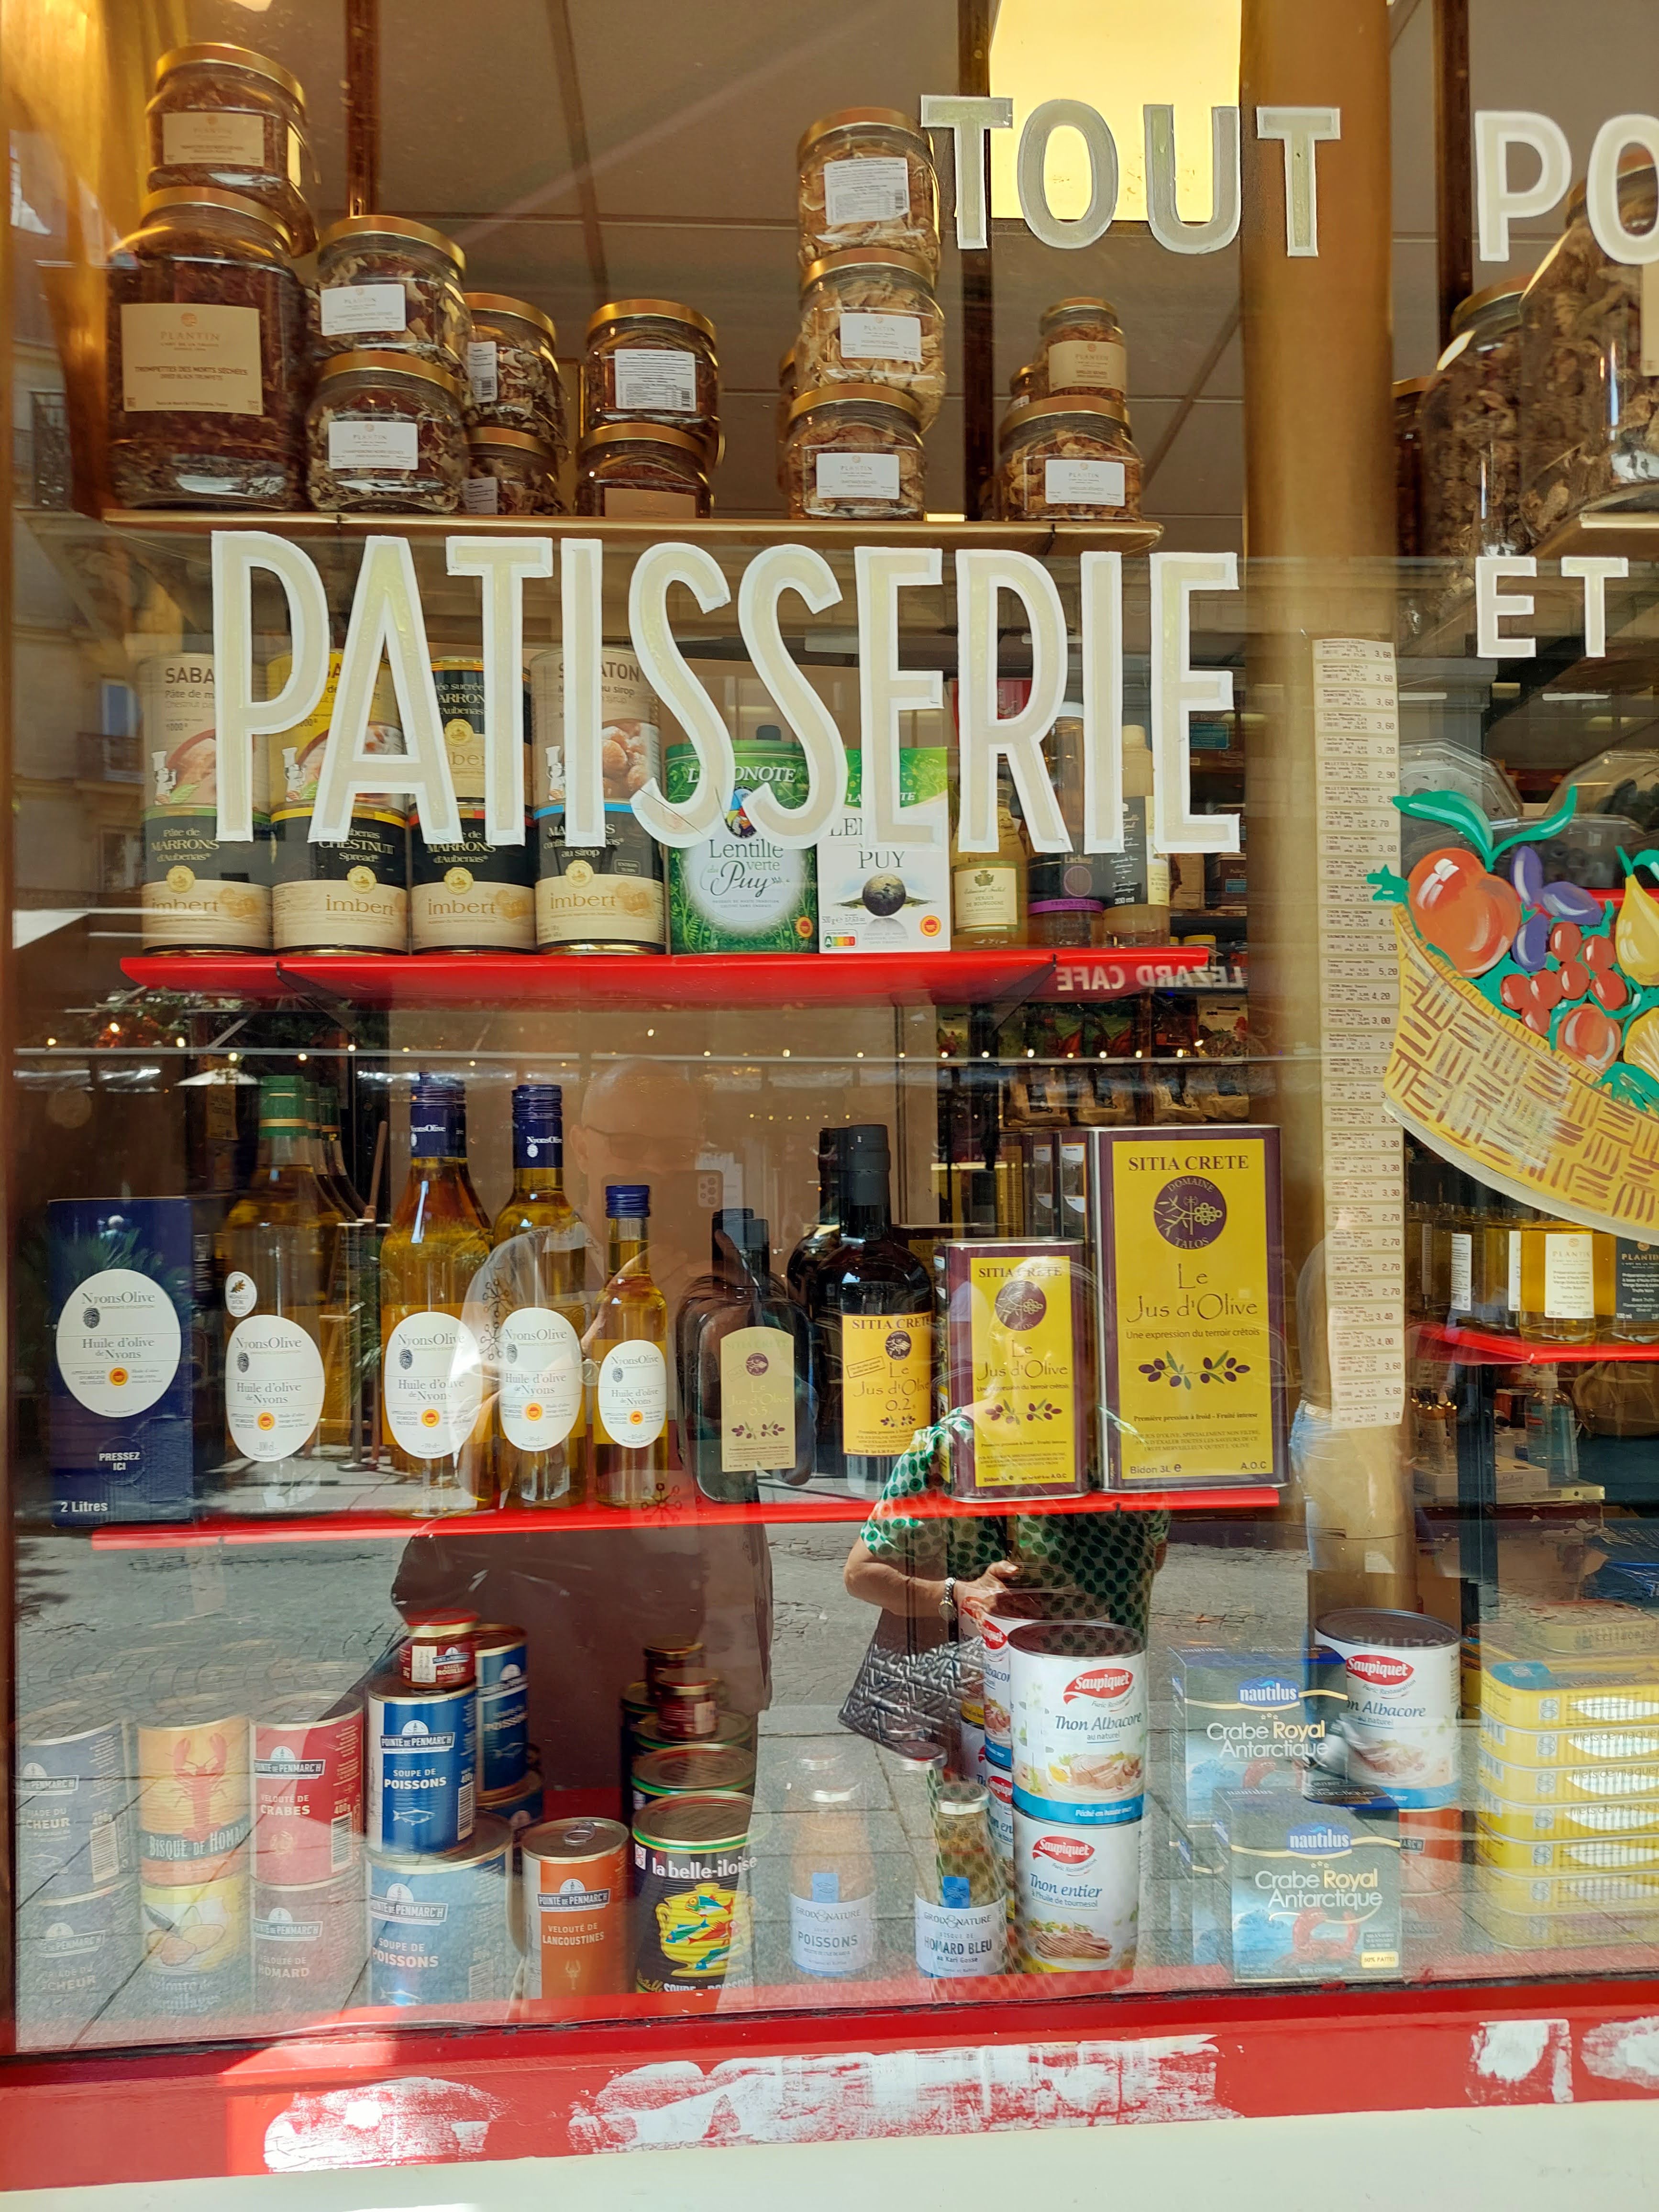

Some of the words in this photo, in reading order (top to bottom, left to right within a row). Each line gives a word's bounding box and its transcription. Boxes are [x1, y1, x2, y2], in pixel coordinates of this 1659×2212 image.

[920, 94, 1341, 257] TOUT
[1475, 110, 1659, 265] PO
[1474, 555, 1628, 658] ET
[188, 690, 201, 698] de
[211, 530, 1240, 854] PATISSERIE
[186, 828, 200, 837] de
[468, 830, 483, 839] de
[151, 839, 220, 852] MARRONS
[319, 840, 395, 855] CHESTNUT
[427, 841, 496, 853] MARRONS
[708, 839, 784, 858] Lentille
[574, 848, 600, 859] sirop
[857, 851, 905, 869] PUY
[746, 861, 780, 871] verte
[710, 860, 771, 897] Puy
[152, 898, 219, 913] imbert
[326, 894, 394, 916] imbert
[428, 898, 496, 915] imbert
[550, 892, 616, 909] imbert
[1128, 1157, 1180, 1171] SITIA
[1184, 1156, 1249, 1170] CRETE
[1168, 1177, 1214, 1193] DOMAINE
[1175, 1237, 1209, 1249] TALOS
[979, 1266, 1012, 1279] SITIA
[1178, 1263, 1208, 1289] Le
[81, 1291, 155, 1306] NyonsOlive
[1126, 1295, 1170, 1322] Jus
[1177, 1293, 1258, 1320] d'Olive
[852, 1319, 892, 1329] SITIA
[398, 1333, 465, 1348] NyonsOlive
[505, 1328, 567, 1342] NyonsOlive
[1126, 1331, 1144, 1339] Une
[1145, 1329, 1190, 1340] expression
[1193, 1329, 1203, 1338] du
[1206, 1328, 1231, 1337] terroir
[82, 1338, 114, 1349] Huile
[118, 1337, 155, 1348] d'olive
[236, 1337, 302, 1351] NyonsOlive
[1011, 1339, 1033, 1358] Le
[104, 1349, 142, 1361] Nyons
[611, 1354, 659, 1365] NyonsOlive
[889, 1362, 909, 1378] Le
[976, 1362, 1006, 1381] Jus
[1011, 1360, 1068, 1378] d'Olive
[398, 1379, 426, 1390] Huile
[505, 1373, 529, 1383] Huile
[533, 1372, 566, 1383] d'olive
[236, 1382, 262, 1393] Huile
[265, 1382, 302, 1393] d'olive
[521, 1384, 555, 1397] Nyons
[611, 1389, 633, 1397] Huile
[751, 1381, 766, 1393] Le
[853, 1381, 884, 1397] Jus
[254, 1394, 288, 1406] Nyons
[417, 1391, 452, 1403] Nyons
[626, 1397, 651, 1406] Nyons
[726, 1395, 747, 1408] Jus
[99, 1452, 141, 1461] PRESSEZ
[112, 1462, 126, 1471] ICI
[1130, 1466, 1158, 1474] Bidon
[1240, 1461, 1267, 1470] A.O.C
[60, 1502, 68, 1513] 2
[71, 1501, 108, 1513] Litres
[1347, 1658, 1408, 1678] Saupiquet
[1074, 1670, 1130, 1692] Saupiquet
[1239, 1685, 1297, 1702] nautilus
[1361, 1699, 1427, 1717] Albacore
[1055, 1715, 1088, 1731] Thon
[1091, 1712, 1142, 1731] Albacore
[1206, 1722, 1270, 1741] Crabe
[1273, 1719, 1326, 1744] Royal
[1600, 1730, 1616, 1741] de
[1220, 1739, 1329, 1760] Antarctique
[1599, 1768, 1615, 1779] de
[384, 1776, 447, 1790] POISSONS
[297, 1794, 310, 1802] DE
[260, 1804, 310, 1816] CRABES
[1597, 1804, 1613, 1814] de
[1289, 1829, 1350, 1849] nautilus
[149, 1835, 188, 1860] BISQUE
[193, 1841, 205, 1856] DE
[1040, 1838, 1090, 1858] Saupiquet
[652, 1857, 665, 1877] la
[668, 1856, 758, 1880] belle-iloise
[1030, 1873, 1057, 1893] Thon
[1061, 1883, 1103, 1898] entier
[1254, 1870, 1319, 1890] Crabe
[1323, 1868, 1378, 1892] Royal
[539, 1895, 561, 1906] POINTE
[1063, 1898, 1098, 1908] tournesol
[1268, 1888, 1383, 1911] Antarctique
[547, 1924, 585, 1933] VELOUTÉ
[587, 1922, 598, 1931] DE
[378, 1937, 408, 1952] SOUPE
[410, 1942, 425, 1953] DE
[542, 1931, 605, 1947] LANGOUSTINES
[798, 1931, 858, 1948] POISSONS
[924, 1936, 964, 1955] HOMARD
[968, 1938, 992, 1954] BLEU
[371, 1947, 439, 1969] POISSONS
[258, 1964, 310, 1978] HOMARD
